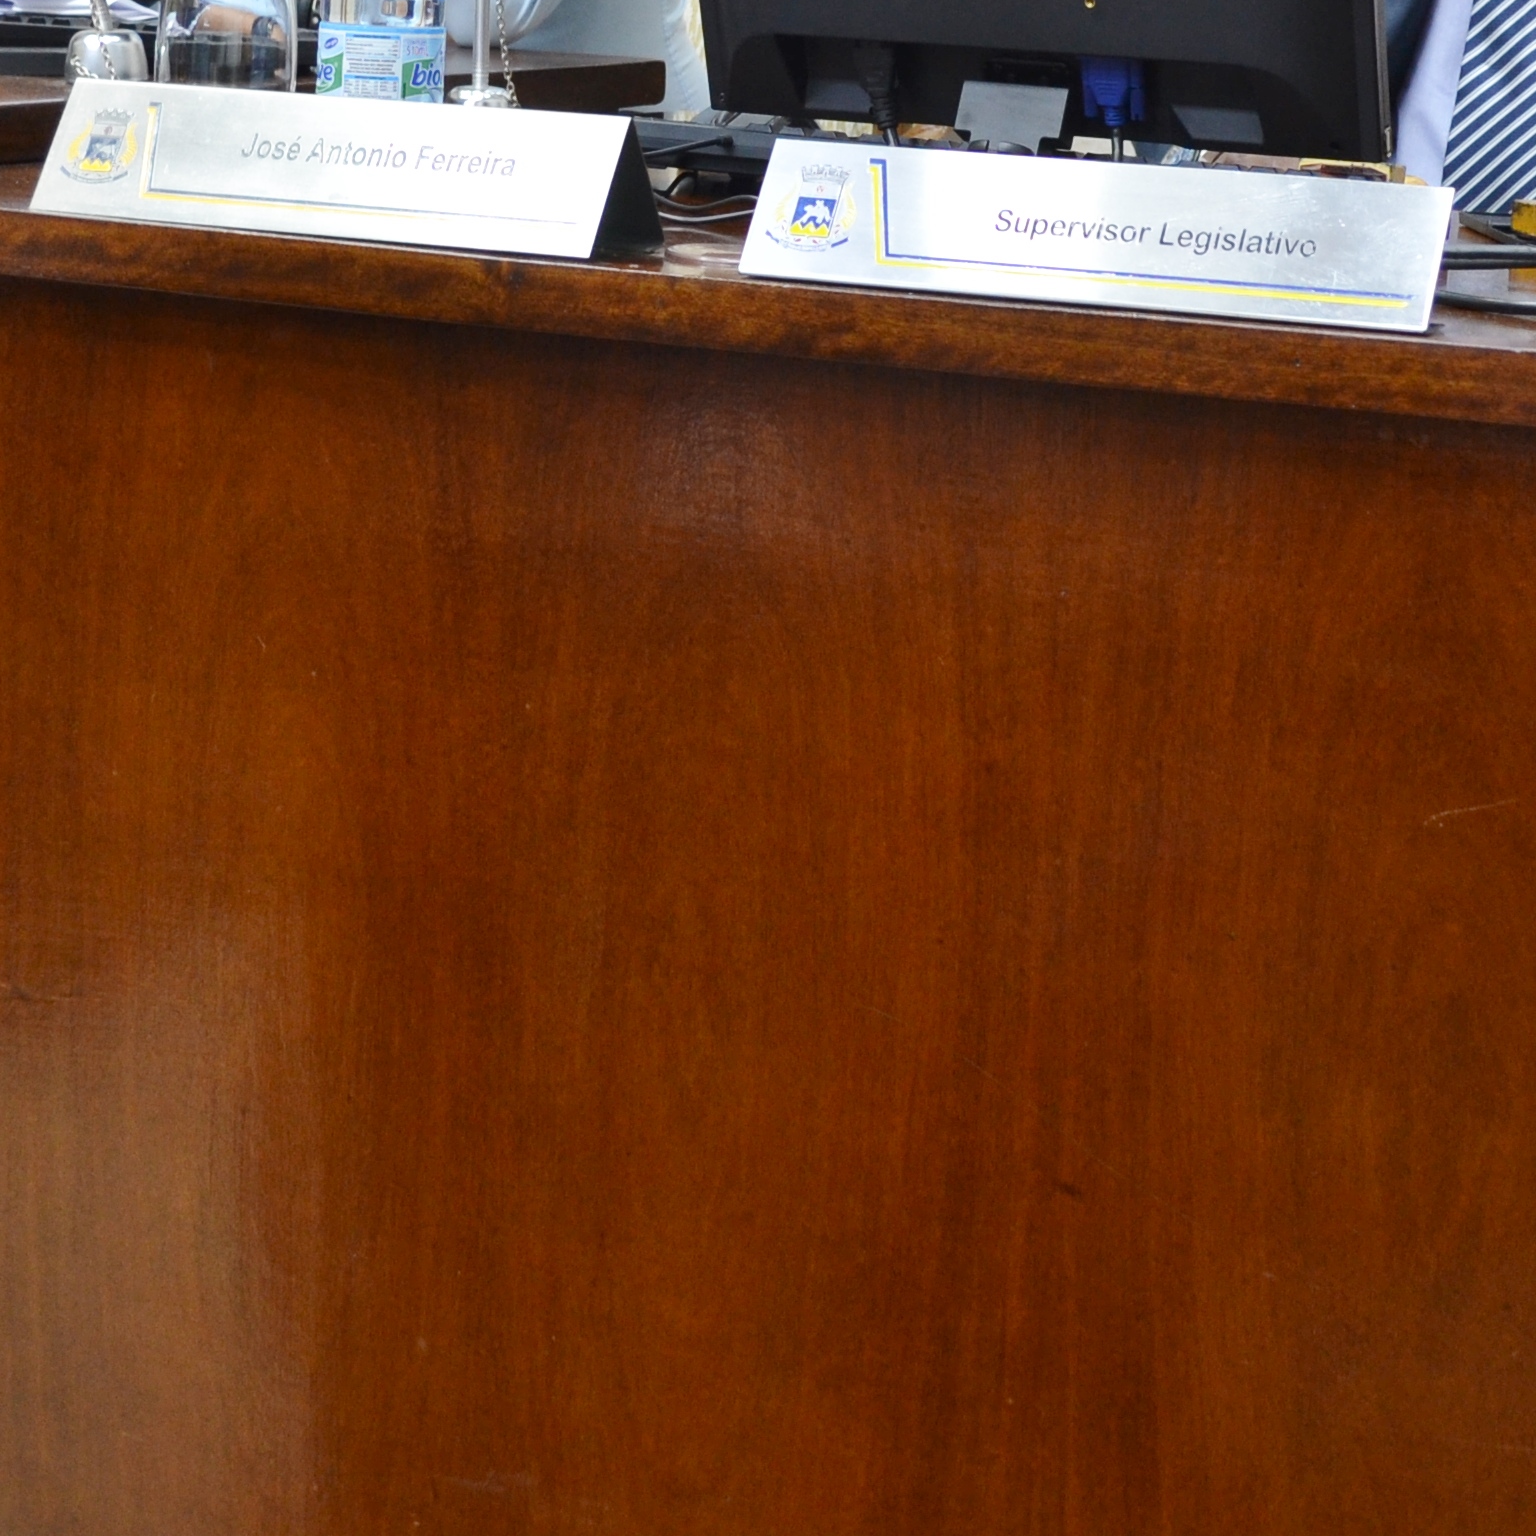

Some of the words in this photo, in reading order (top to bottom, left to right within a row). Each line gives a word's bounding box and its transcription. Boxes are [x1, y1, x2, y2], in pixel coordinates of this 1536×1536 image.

[241, 133, 301, 161] José
[305, 137, 407, 168] Antonio
[414, 144, 516, 176] Ferreira
[995, 209, 1151, 243] Supervisor
[1158, 222, 1317, 257] Legislativo
